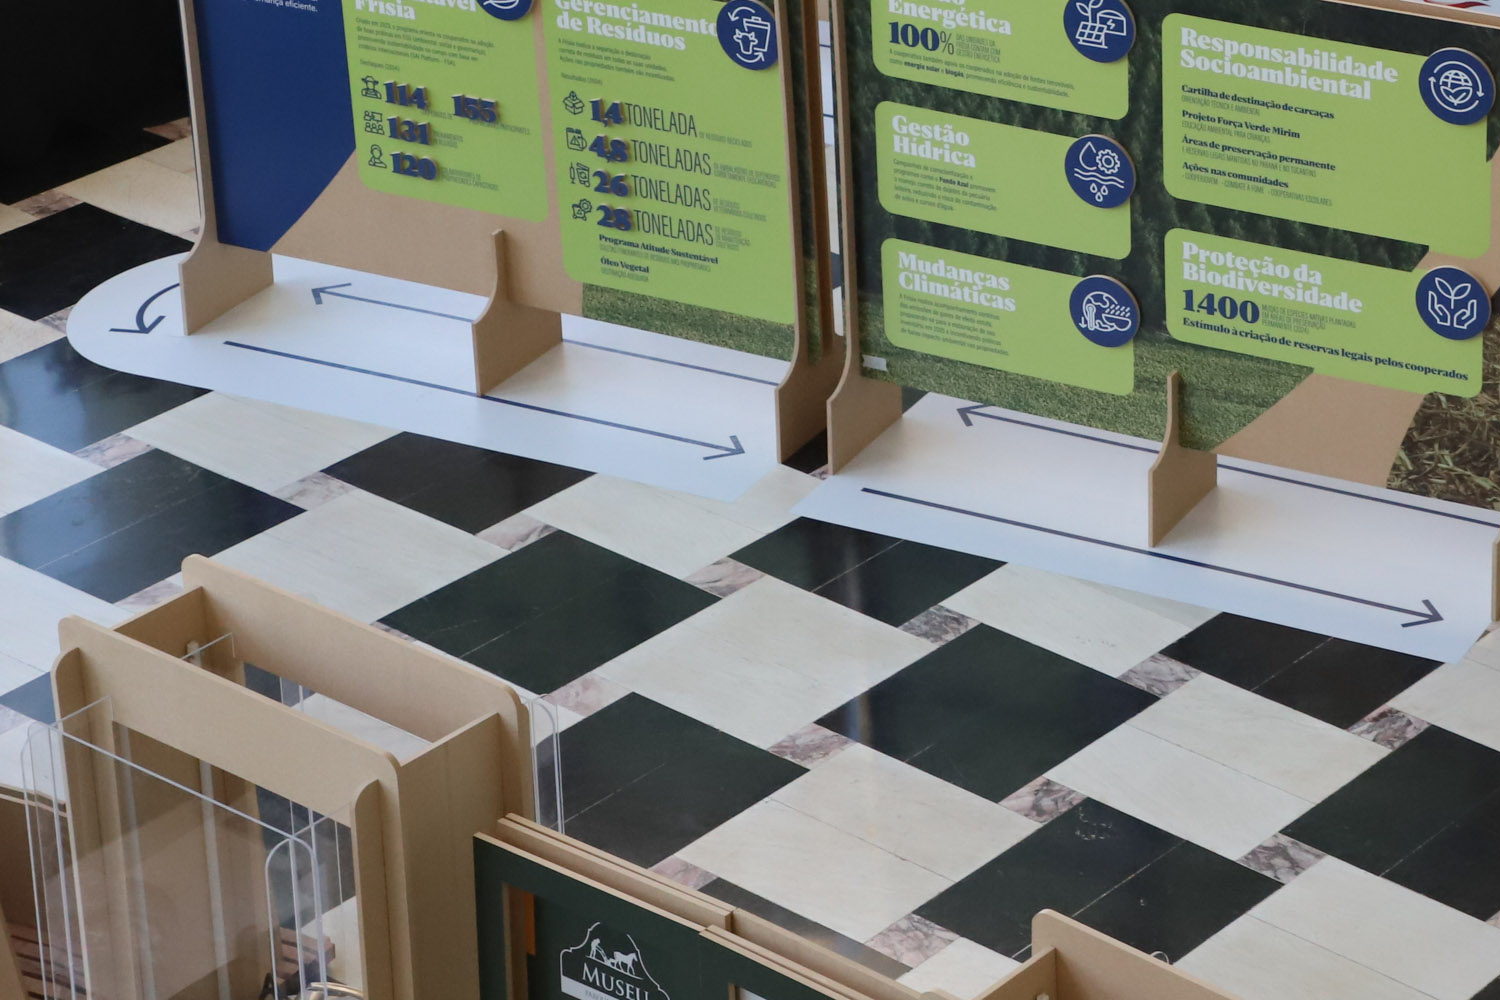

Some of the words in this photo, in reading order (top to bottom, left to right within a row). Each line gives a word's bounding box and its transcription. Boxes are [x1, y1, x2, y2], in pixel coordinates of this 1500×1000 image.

[556, 14, 584, 32] de
[586, 15, 687, 51] Resíduos
[888, 21, 955, 56] 100%
[1179, 26, 1400, 85] Responsabilidade
[1179, 48, 1373, 101] Socioambiental
[383, 79, 428, 111] 114
[451, 93, 499, 124] 155
[387, 115, 432, 146] 131
[588, 98, 624, 128] 1,4
[625, 102, 698, 138] TONELADA
[891, 114, 971, 148] Gestão
[390, 151, 438, 181] 120
[588, 133, 629, 163] 4,8
[630, 139, 712, 176] TONELADAS
[892, 132, 977, 169] Hídrica
[592, 168, 630, 197] 26
[630, 174, 712, 211] TONELADAS
[596, 202, 633, 232] 28
[632, 209, 714, 246] TONELADAS
[898, 251, 1011, 292] Mudanças
[1182, 240, 1290, 281] Proteção
[1297, 263, 1323, 287] da
[898, 270, 1017, 313] Climáticas
[1182, 260, 1364, 315] Biodiversidade
[1182, 288, 1260, 324] 1.400
[1183, 316, 1231, 335] Estímulo
[1231, 326, 1240, 336] à
[1240, 329, 1278, 344] criação
[1278, 336, 1292, 347] de
[1293, 340, 1341, 356] reservas
[1341, 348, 1374, 362] legais
[1374, 355, 1404, 369] pelos
[1404, 363, 1469, 381] cooperados
[582, 961, 649, 1000] MUSEU
